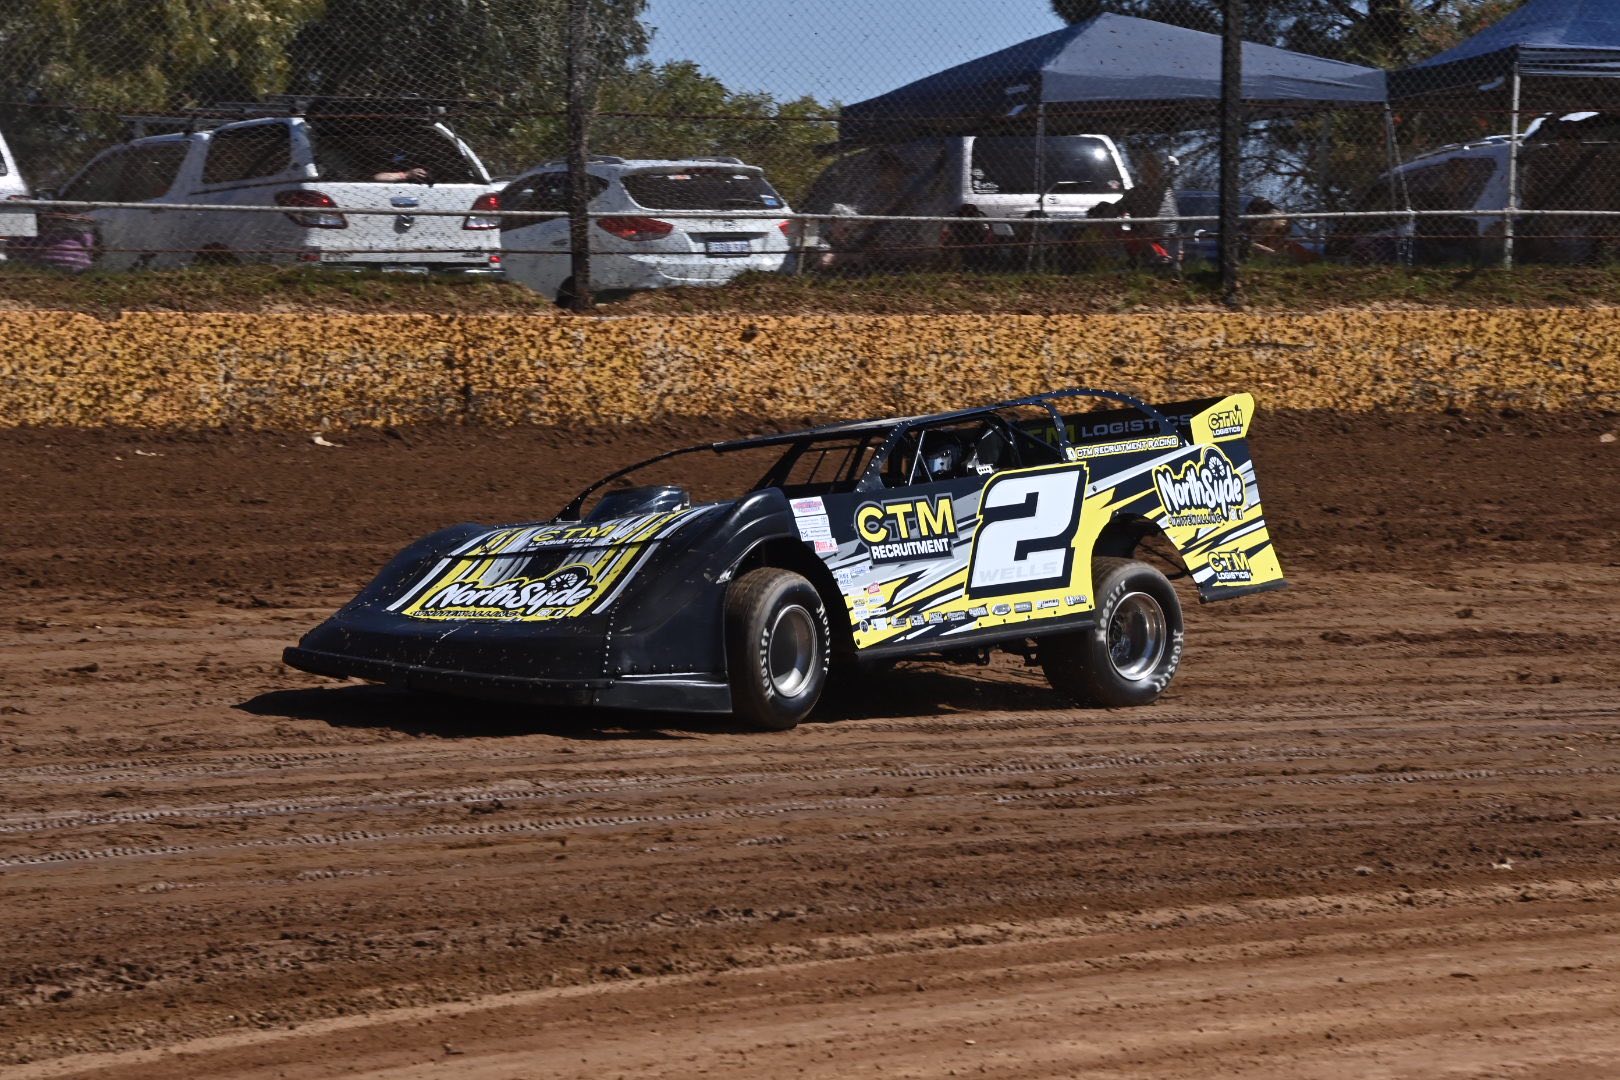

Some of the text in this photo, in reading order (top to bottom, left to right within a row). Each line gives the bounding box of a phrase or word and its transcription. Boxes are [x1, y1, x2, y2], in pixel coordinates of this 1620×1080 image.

[1081, 413, 1192, 438] LOGISTCS
[1208, 409, 1243, 430] CTM
[1212, 425, 1241, 436] LOGISTICS
[1077, 437, 1177, 457] CTM RECRUITMENT RACING
[1157, 464, 1242, 518] NorthSyde
[857, 498, 955, 543] CTM
[971, 470, 1080, 588] 2
[533, 525, 617, 541] CTM
[871, 538, 949, 560] RECRUITMENT
[980, 561, 1057, 583] WELLS
[1208, 551, 1250, 572] CTM
[424, 580, 593, 615] NorthSyde
